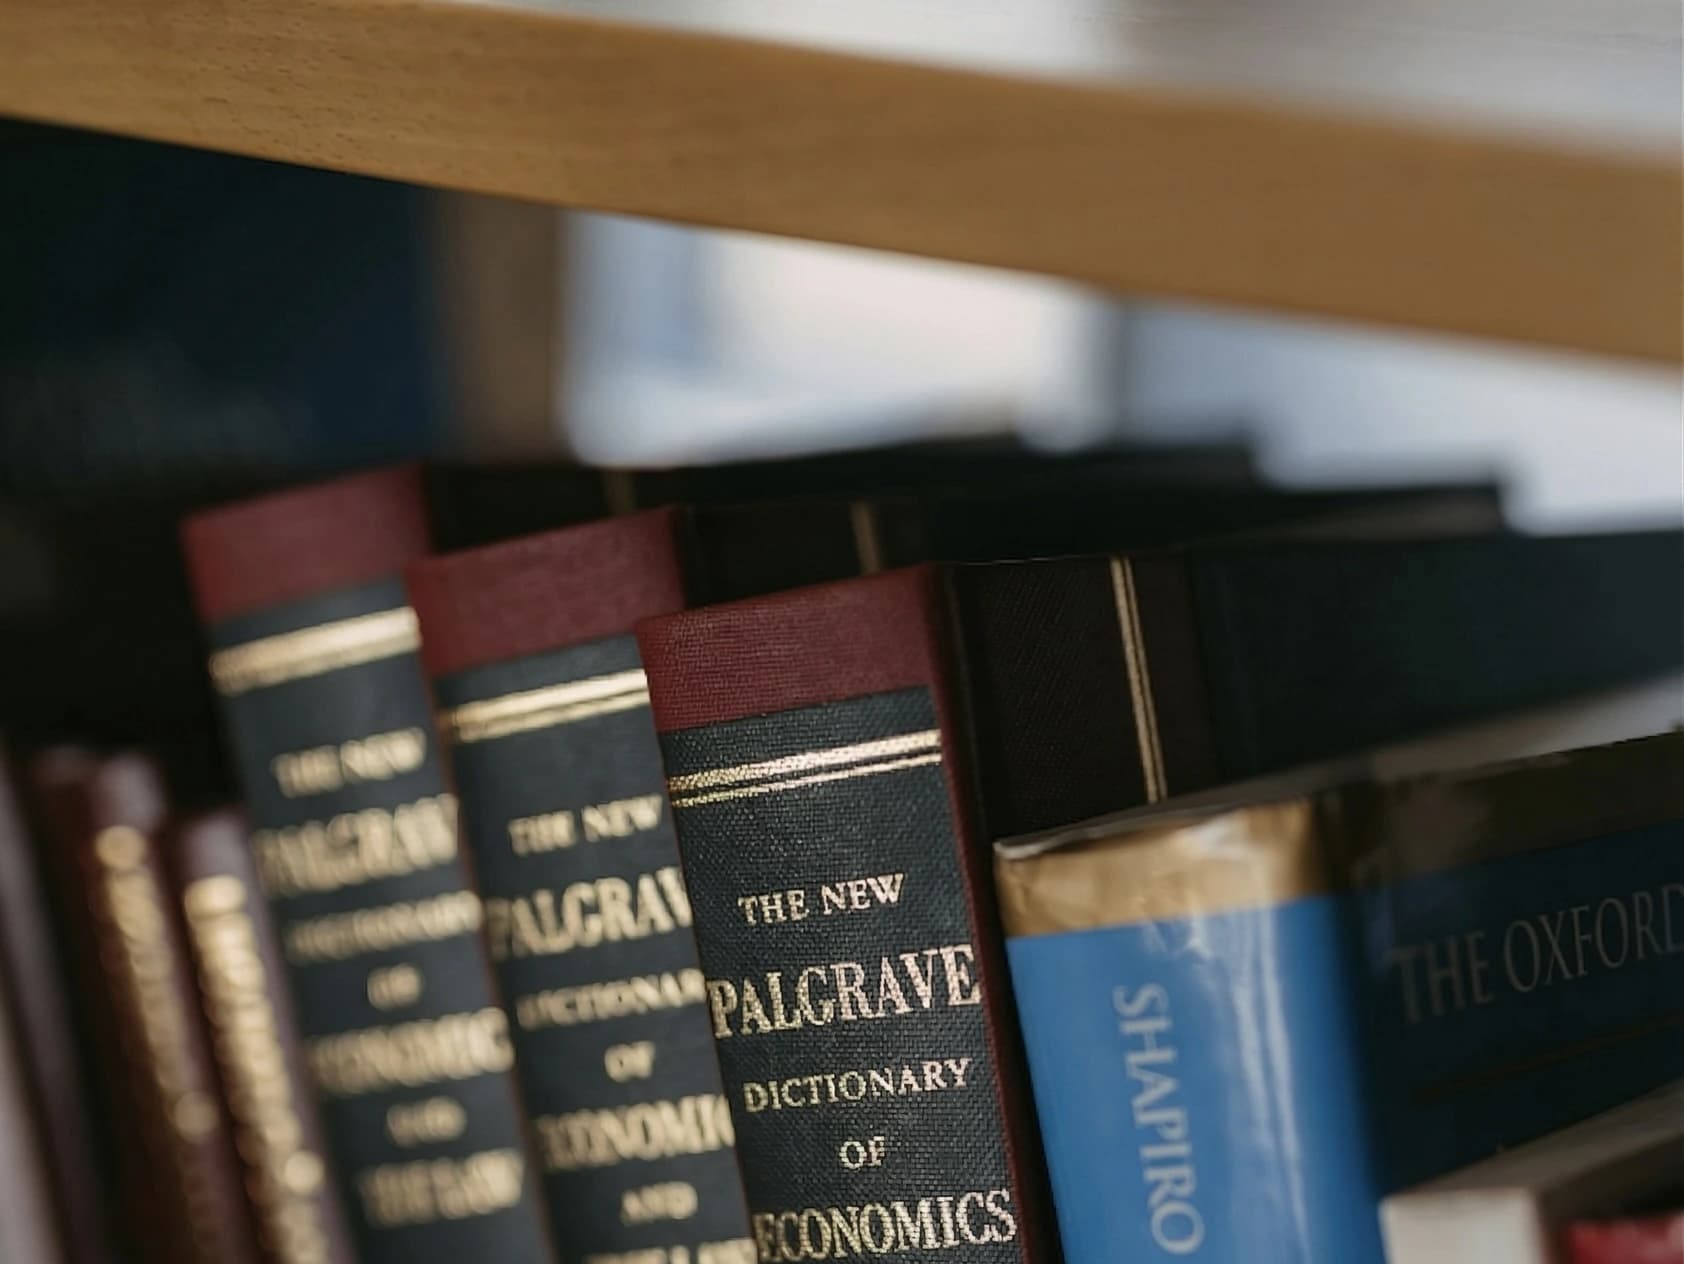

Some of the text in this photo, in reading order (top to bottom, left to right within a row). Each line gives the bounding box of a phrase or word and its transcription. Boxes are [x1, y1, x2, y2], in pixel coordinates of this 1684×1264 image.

[487, 866, 692, 961] PALGRAV
[738, 872, 904, 926] THE NEW
[517, 968, 705, 1031] DICTIONAR
[707, 944, 981, 1038] PALGRAVE
[1389, 930, 1495, 1025] THE
[743, 1057, 972, 1112] DICTIONARY
[1112, 982, 1205, 1256] SHAPIRO
[839, 1135, 885, 1170] OF
[753, 1188, 1017, 1263] ECONOMICS
